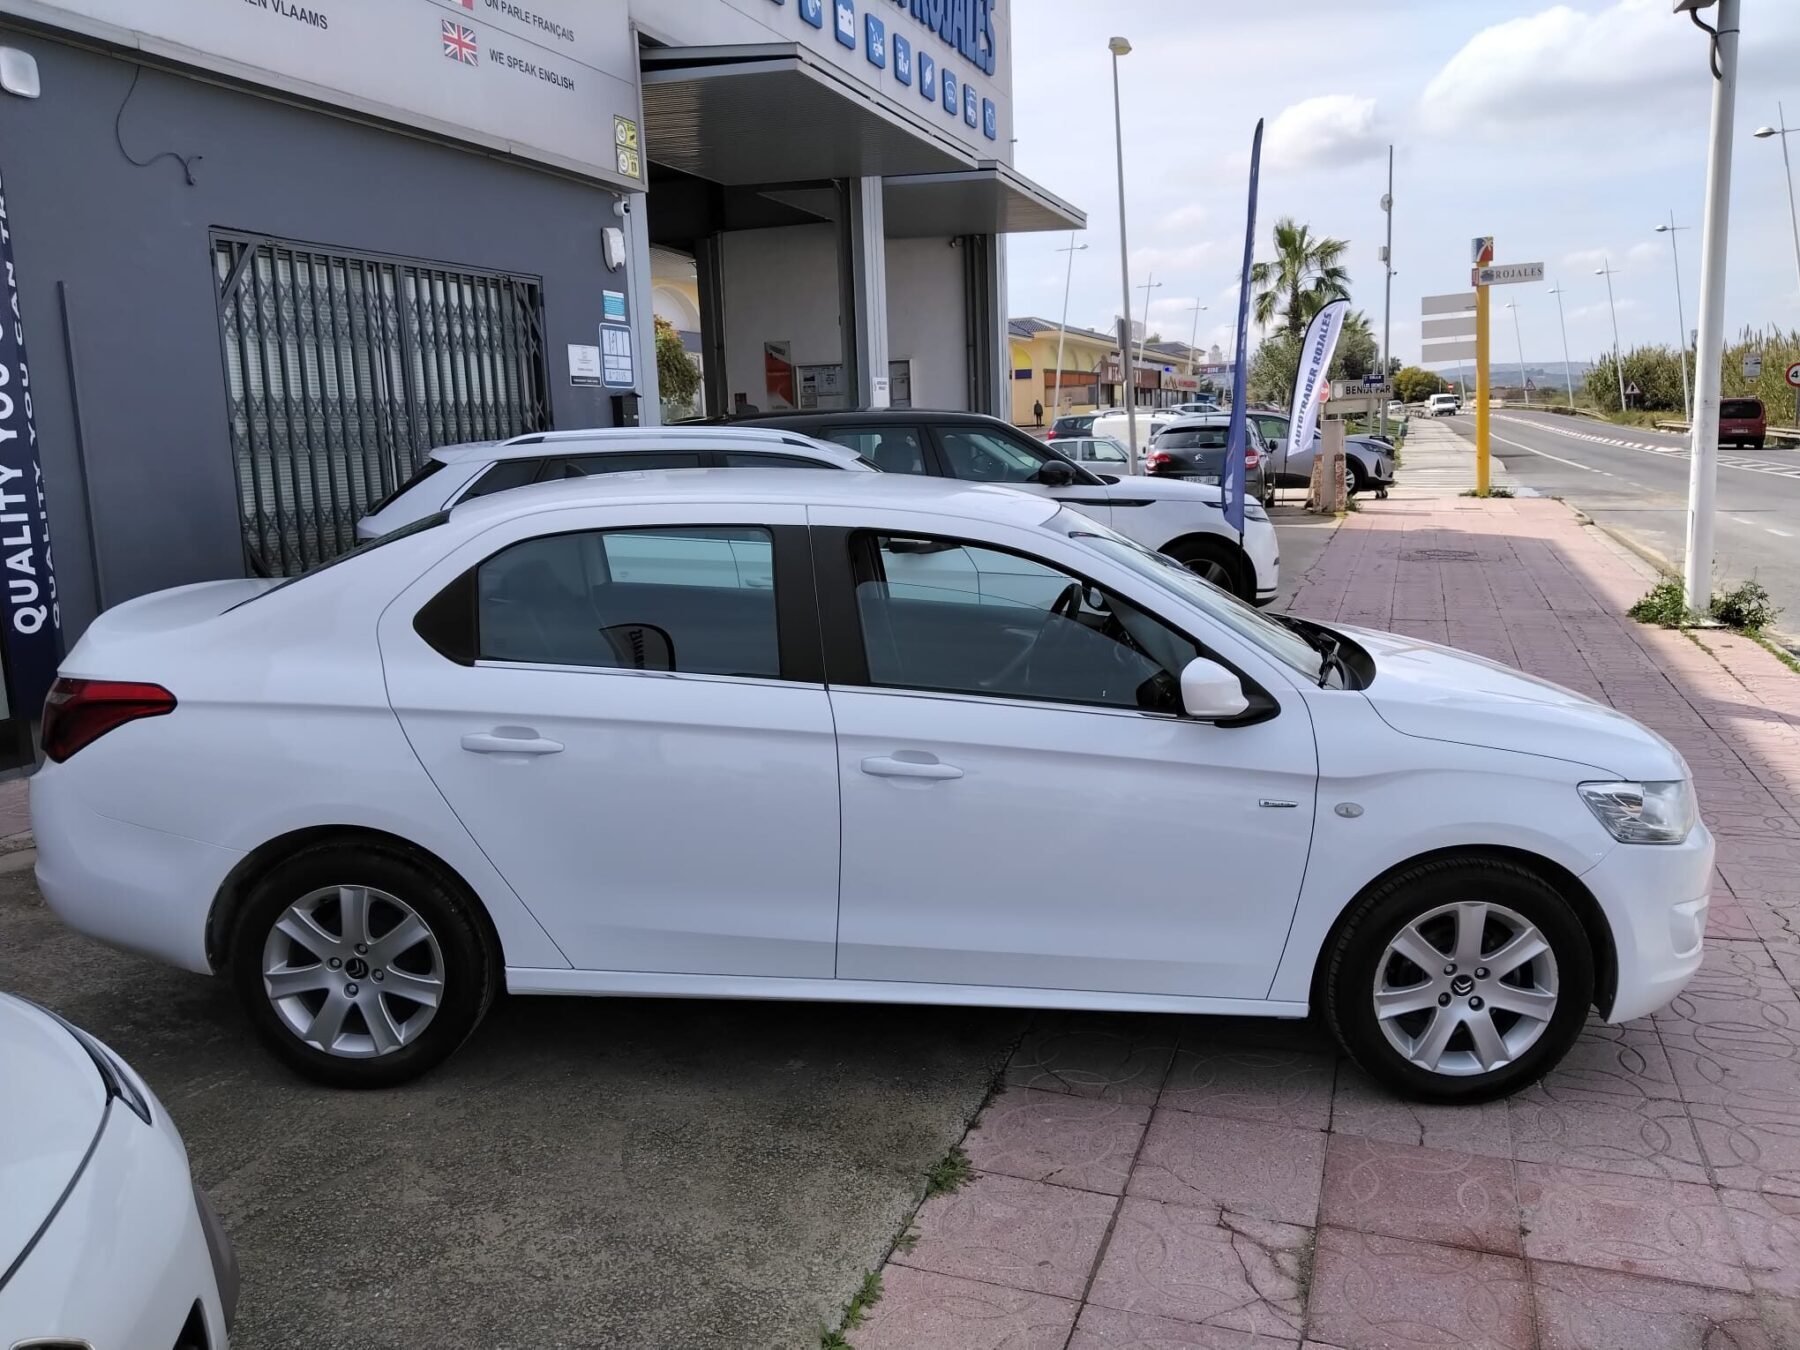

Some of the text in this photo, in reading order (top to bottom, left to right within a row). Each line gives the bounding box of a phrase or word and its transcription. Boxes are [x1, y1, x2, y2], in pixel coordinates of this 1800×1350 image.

[271, 0, 328, 30] VLAAMS
[485, 0, 575, 42] ON PARLE FRANÇAIS
[910, 0, 995, 76] ALES
[489, 48, 575, 91] WE SPEAK ENGLISH
[6, 260, 23, 346] CAN
[1495, 267, 1542, 279] ROJALES
[20, 362, 36, 447] YOU
[1294, 311, 1332, 447] AUTOTRADER ROJALES
[1345, 384, 1391, 395] BENIJFAR
[0, 463, 48, 635] QUALITY
[33, 460, 60, 629] QUALITY
